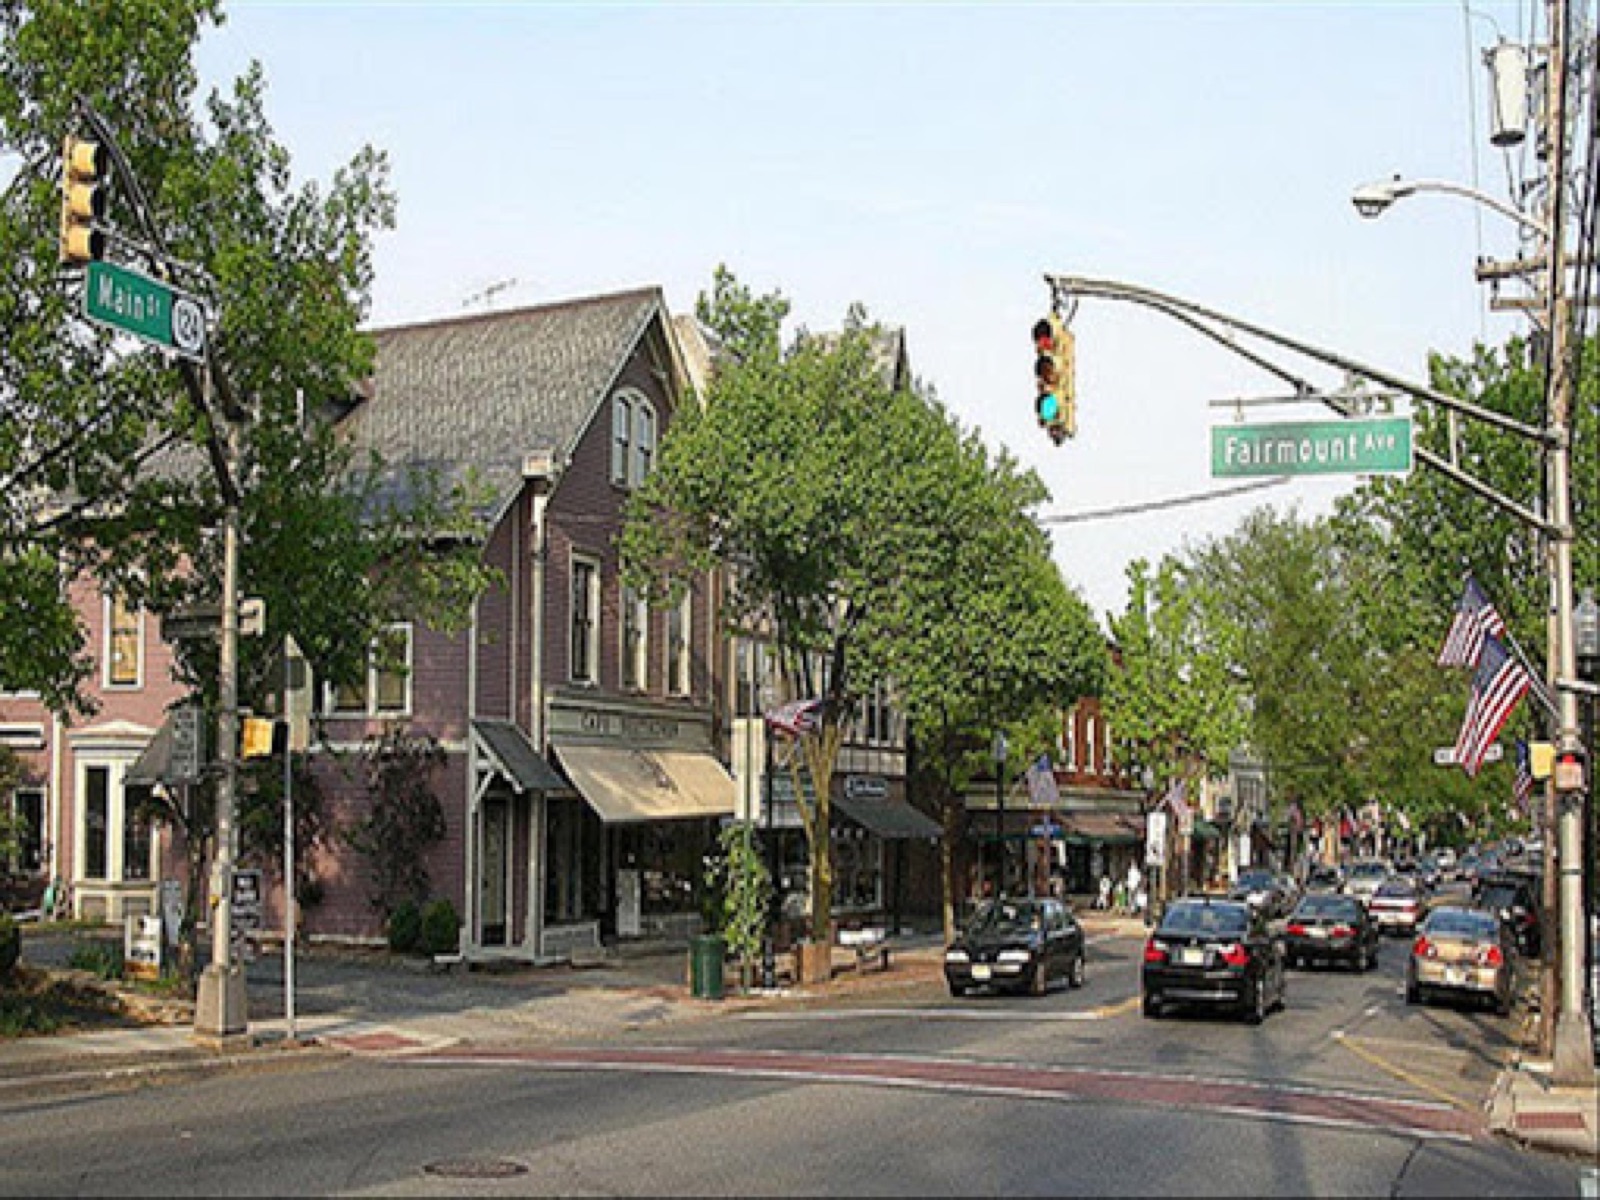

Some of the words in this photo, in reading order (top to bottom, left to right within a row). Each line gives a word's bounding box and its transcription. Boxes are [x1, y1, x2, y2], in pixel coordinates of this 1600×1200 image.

[98, 273, 145, 322] Main
[1224, 433, 1358, 466] Fairmount
[1364, 430, 1396, 450] Ave
